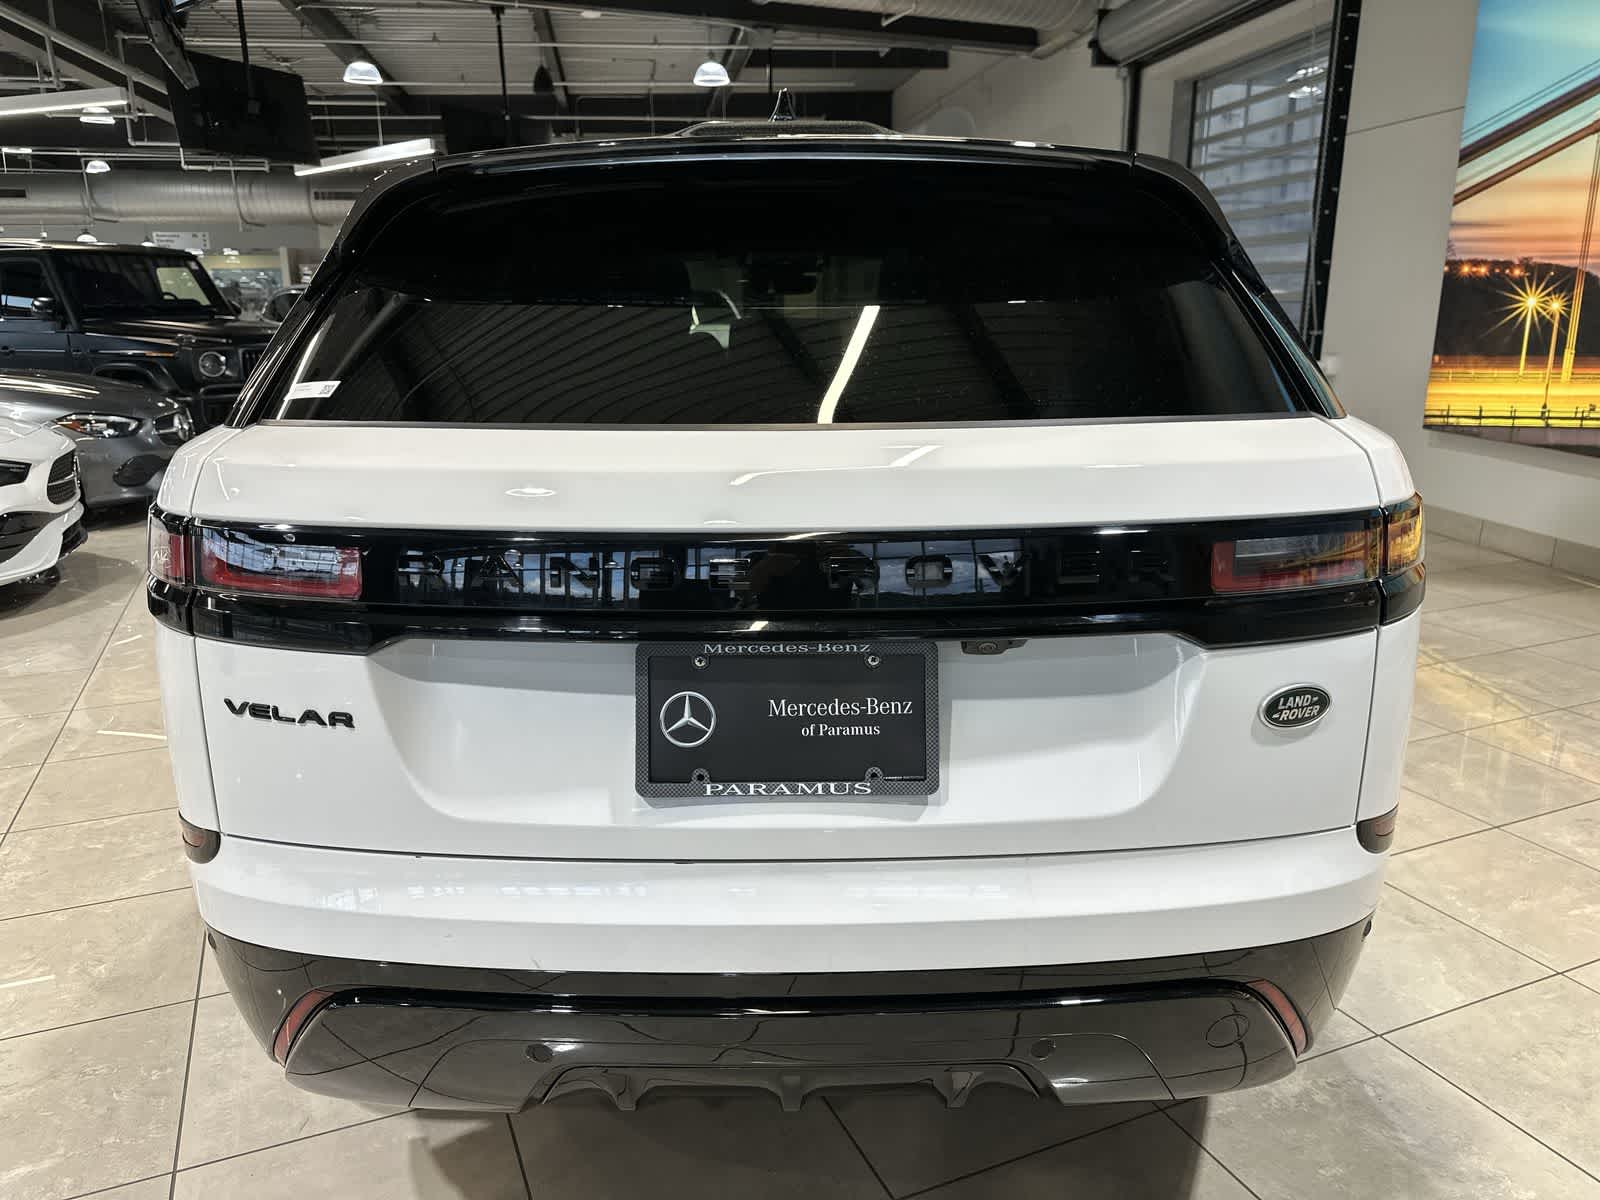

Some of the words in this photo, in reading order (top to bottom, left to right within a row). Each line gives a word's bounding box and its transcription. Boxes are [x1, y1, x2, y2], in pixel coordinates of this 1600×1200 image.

[397, 549, 753, 590] RANGE
[703, 642, 872, 655] Mercedes-Benz
[223, 697, 356, 729] VELAR
[767, 697, 913, 718] Mercedes-Benz
[800, 724, 816, 737] of
[818, 723, 881, 736] Paramus
[702, 782, 873, 796] PARAMUS
